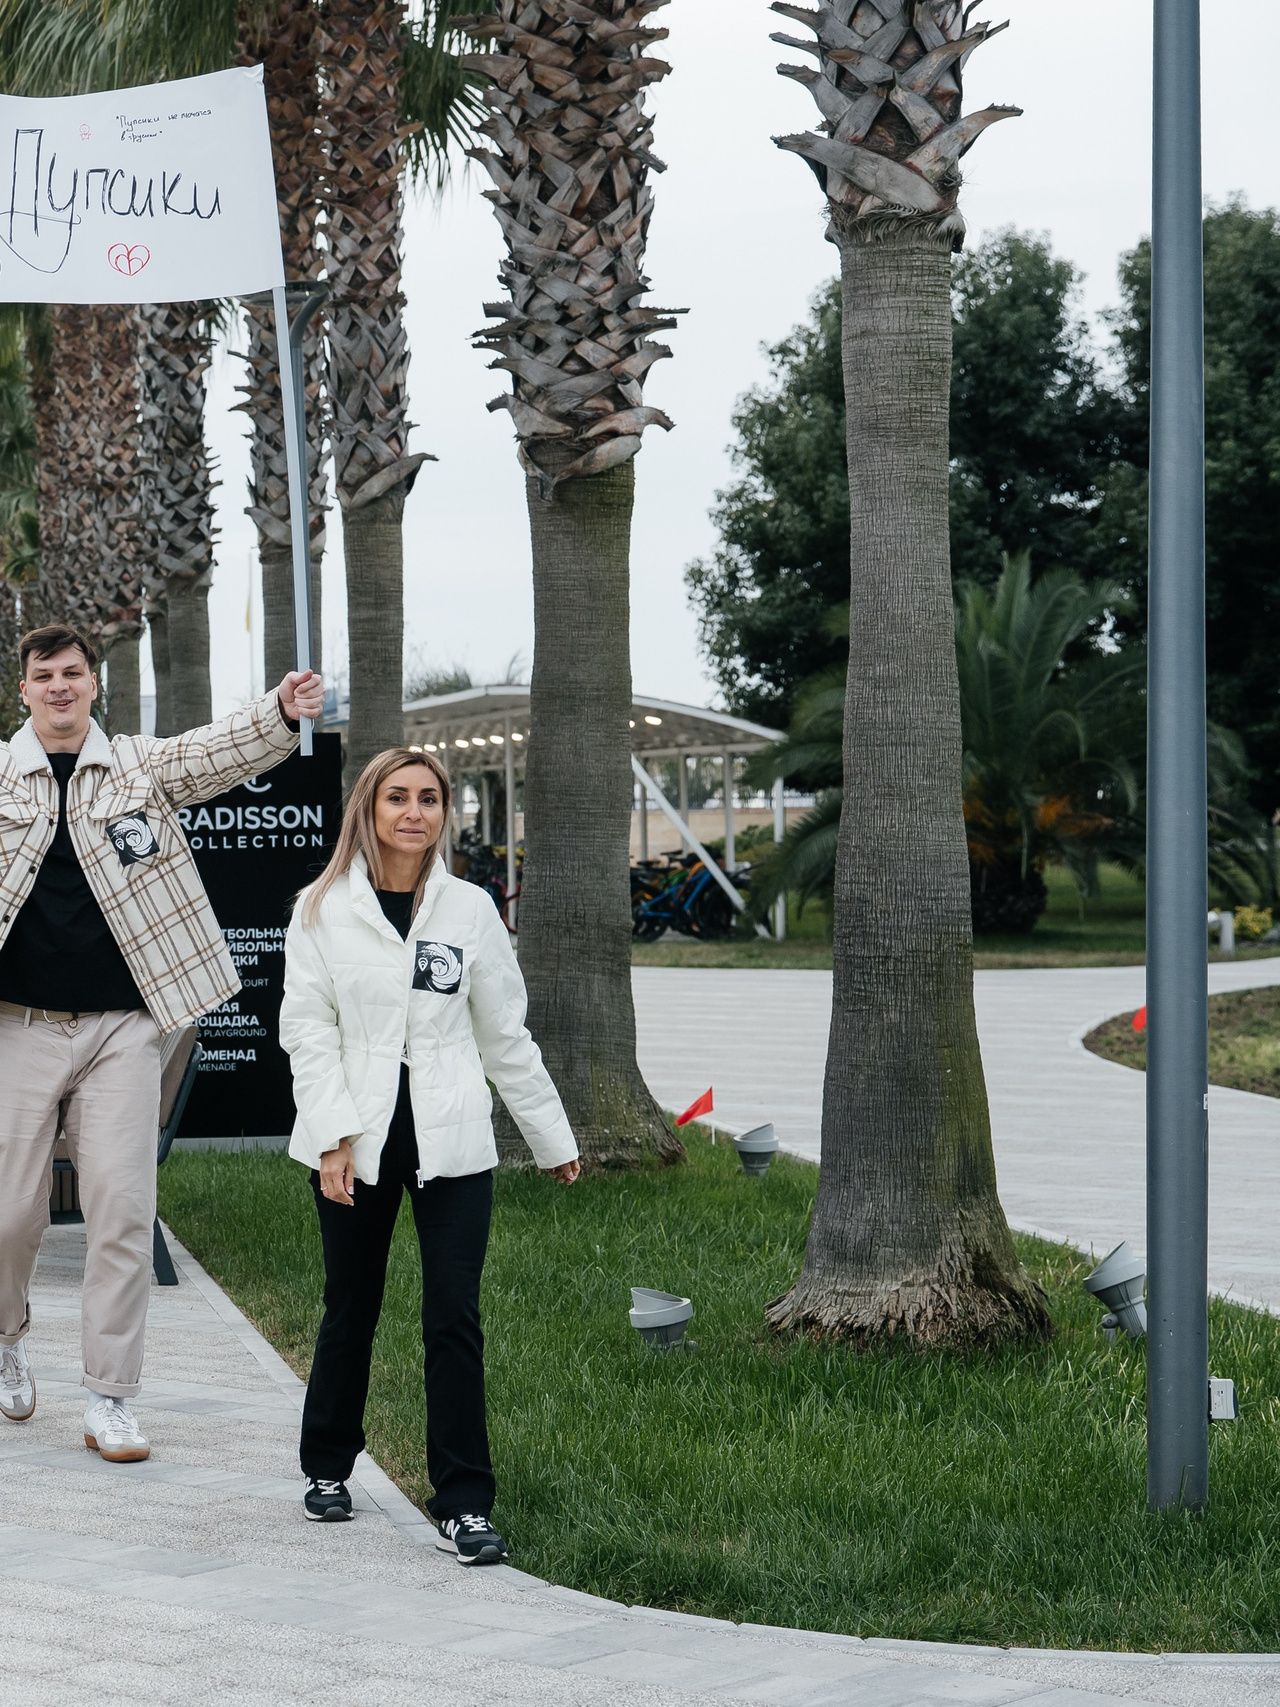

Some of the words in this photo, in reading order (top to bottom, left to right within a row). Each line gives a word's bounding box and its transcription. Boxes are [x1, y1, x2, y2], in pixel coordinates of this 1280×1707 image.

[176, 804, 323, 831] RADISSON
[190, 834, 323, 850] OLLECTION
[221, 927, 287, 939] ТБОЛЬНАЯ
[226, 940, 285, 952] ЙБОЛЬН
[195, 1015, 259, 1028] ОЩАДКА
[204, 1028, 267, 1037] PLAYGROUND
[200, 1049, 256, 1061] ОМЕНАД
[198, 1062, 236, 1071] MENADE
